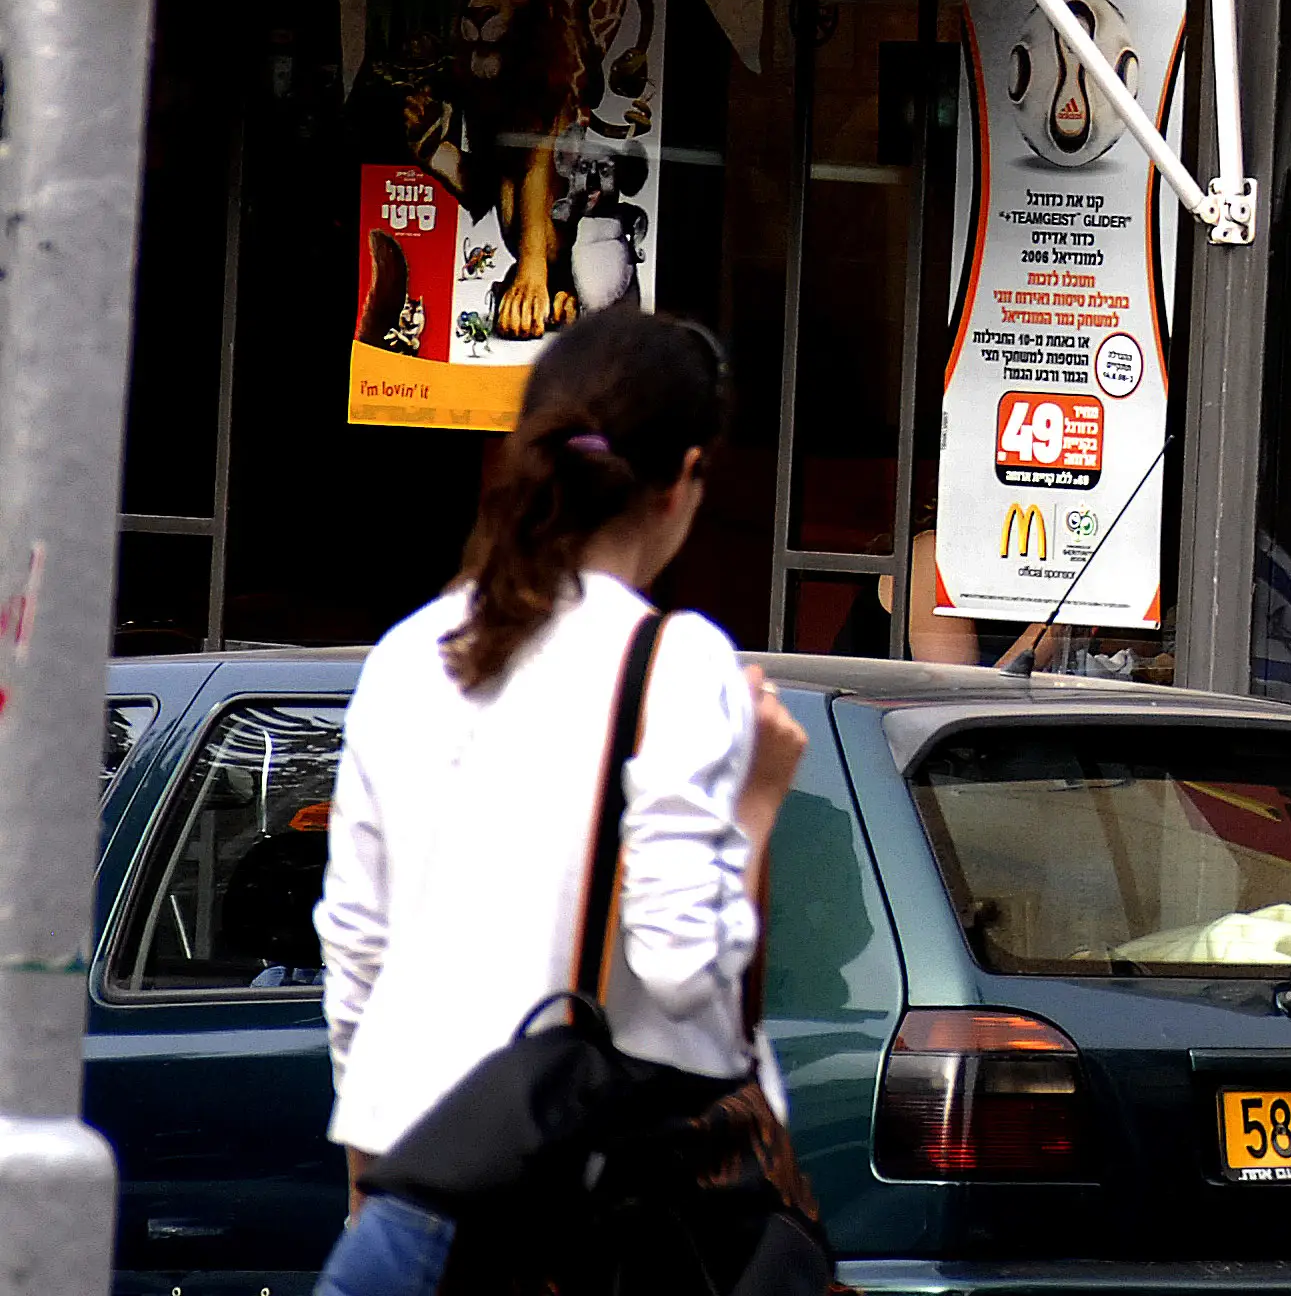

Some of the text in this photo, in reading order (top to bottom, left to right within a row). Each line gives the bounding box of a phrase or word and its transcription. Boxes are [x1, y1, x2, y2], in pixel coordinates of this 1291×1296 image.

[385, 179, 434, 203] ג'ונגל
[1065, 194, 1084, 207] את
[381, 204, 437, 232] סיטי
[1070, 232, 1095, 246] כדור
[1021, 247, 1104, 266] למונדיאל 2006
[360, 380, 429, 400] i'm lovin' it
